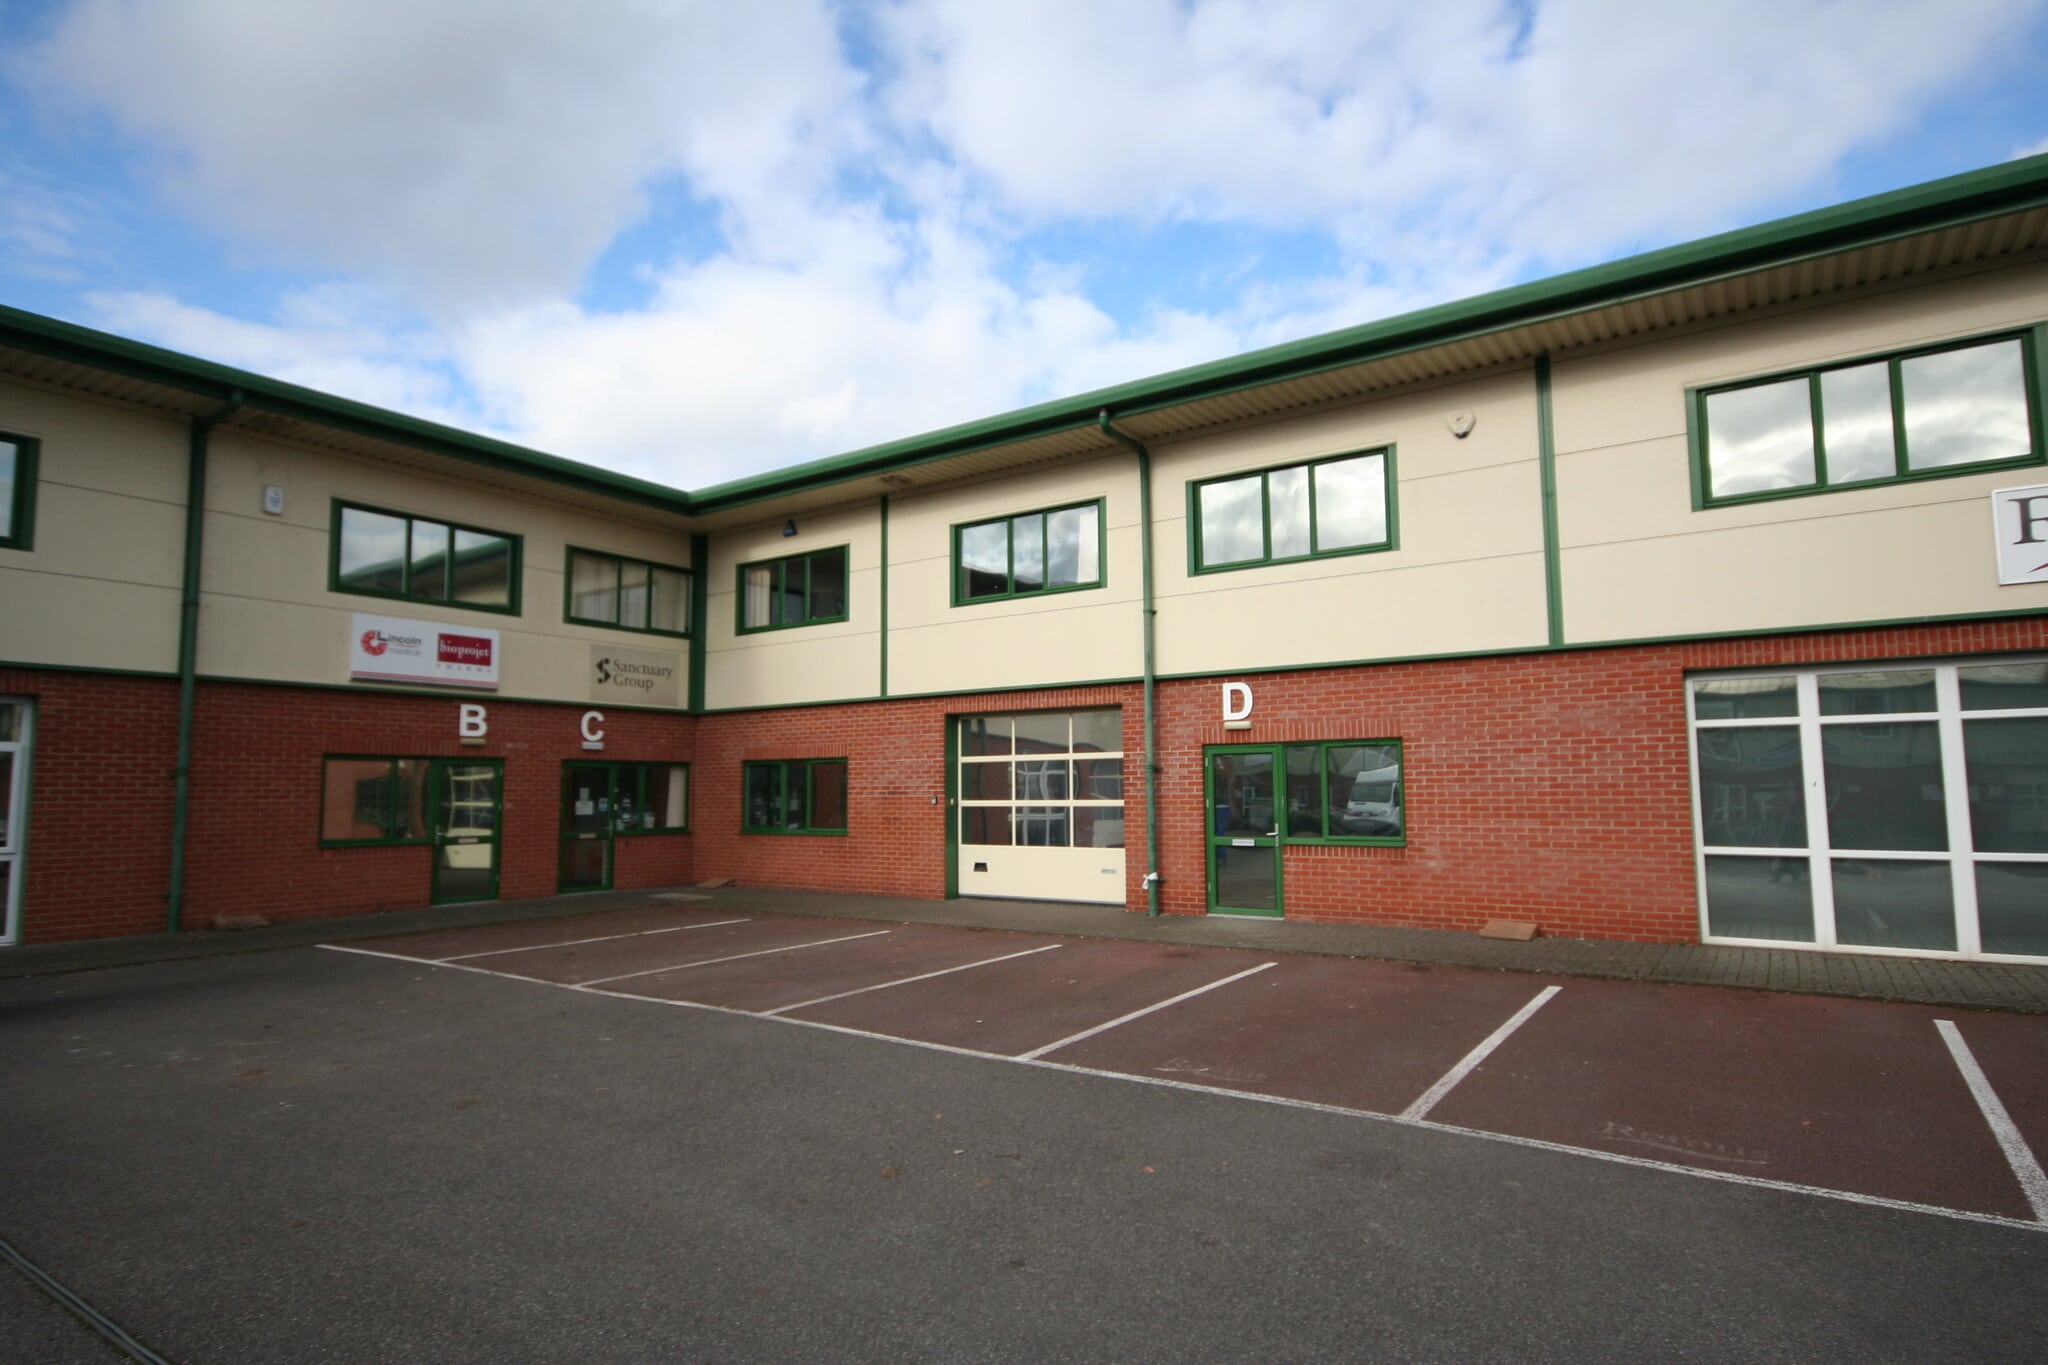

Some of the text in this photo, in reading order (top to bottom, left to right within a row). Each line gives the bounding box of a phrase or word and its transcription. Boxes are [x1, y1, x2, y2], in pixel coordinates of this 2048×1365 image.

[439, 639, 489, 660] bioprojet
[612, 658, 673, 680] Sanctuary
[612, 672, 653, 692] Group
[1222, 681, 1254, 720] D
[459, 704, 490, 738] B
[580, 710, 606, 742] C
